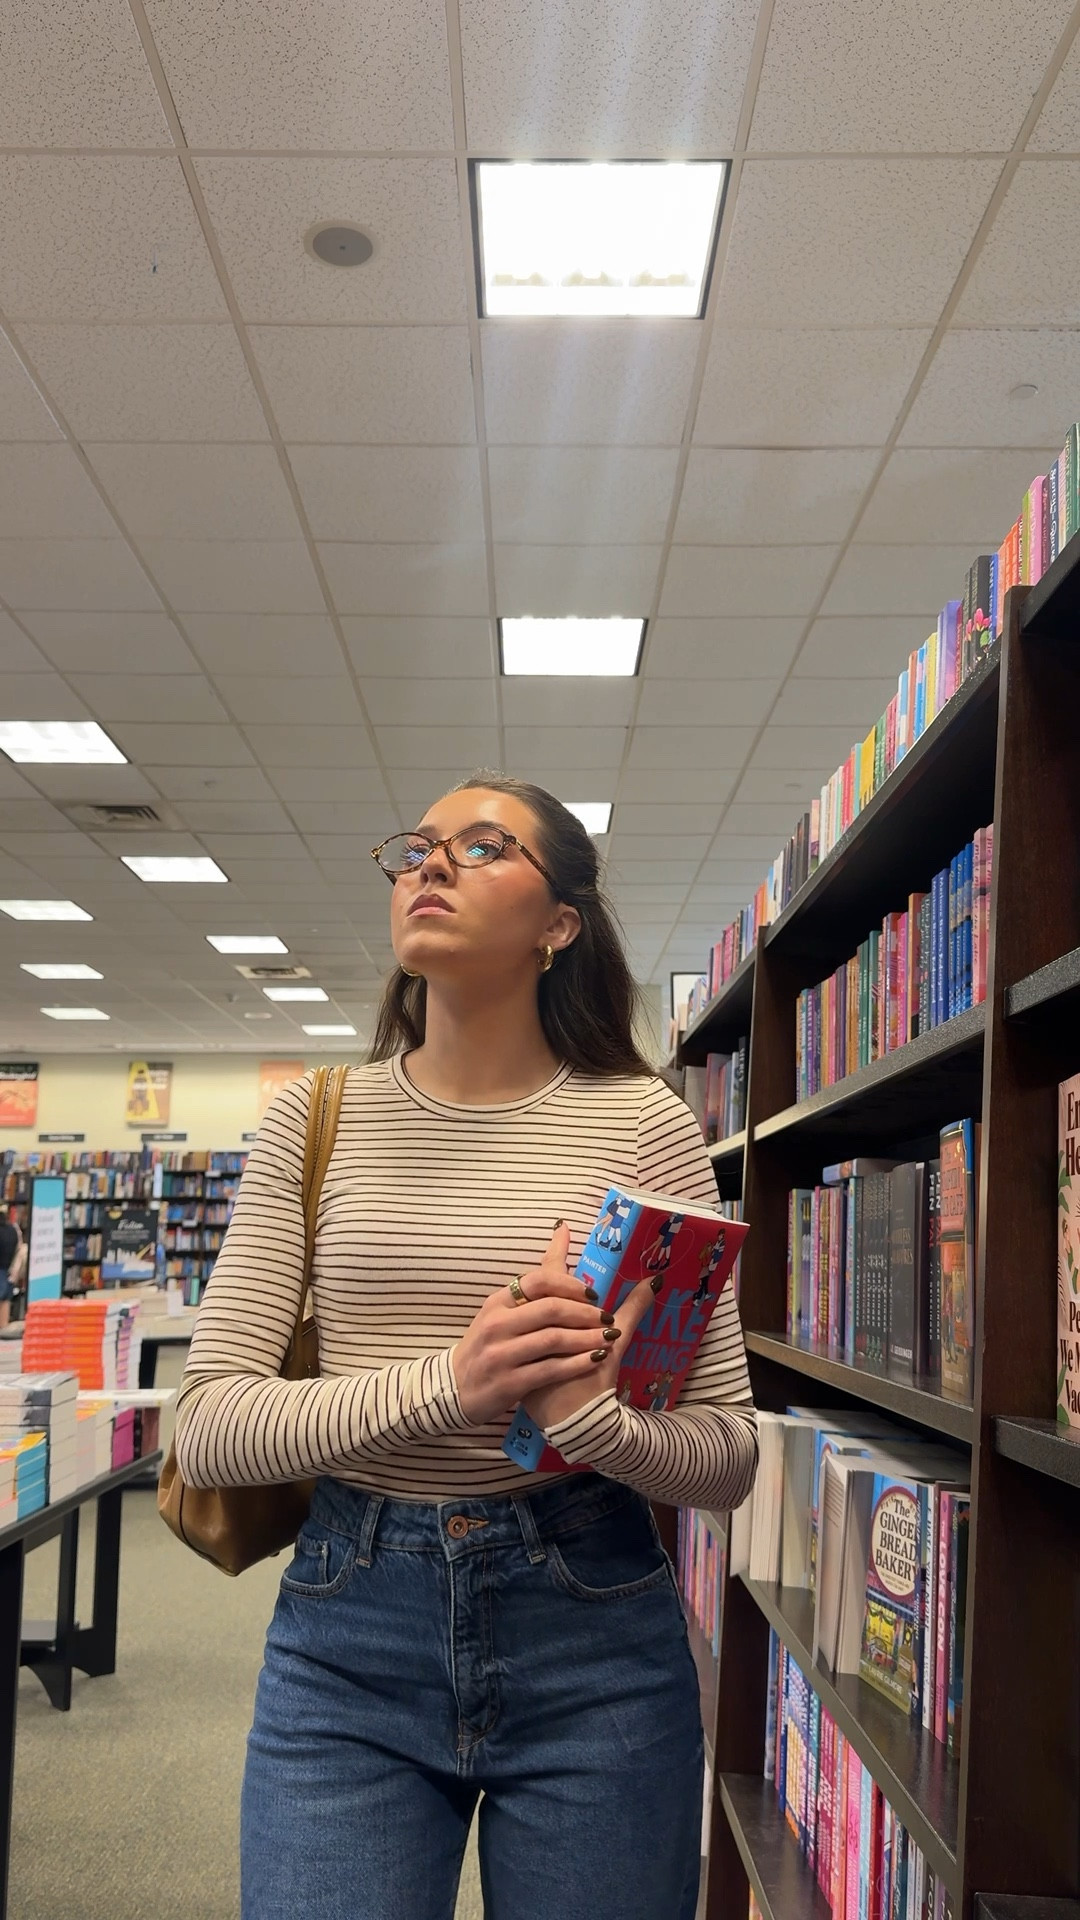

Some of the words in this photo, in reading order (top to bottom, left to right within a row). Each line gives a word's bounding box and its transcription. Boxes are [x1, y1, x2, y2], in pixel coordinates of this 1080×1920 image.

[582, 1256, 607, 1274] PAINTER
[620, 1342, 692, 1372] ATING
[1060, 1339, 1073, 1372] We
[893, 1499, 911, 1518] The
[880, 1530, 918, 1562] BREAD
[938, 1540, 947, 1599] LOVE
[936, 1601, 946, 1651] CON
